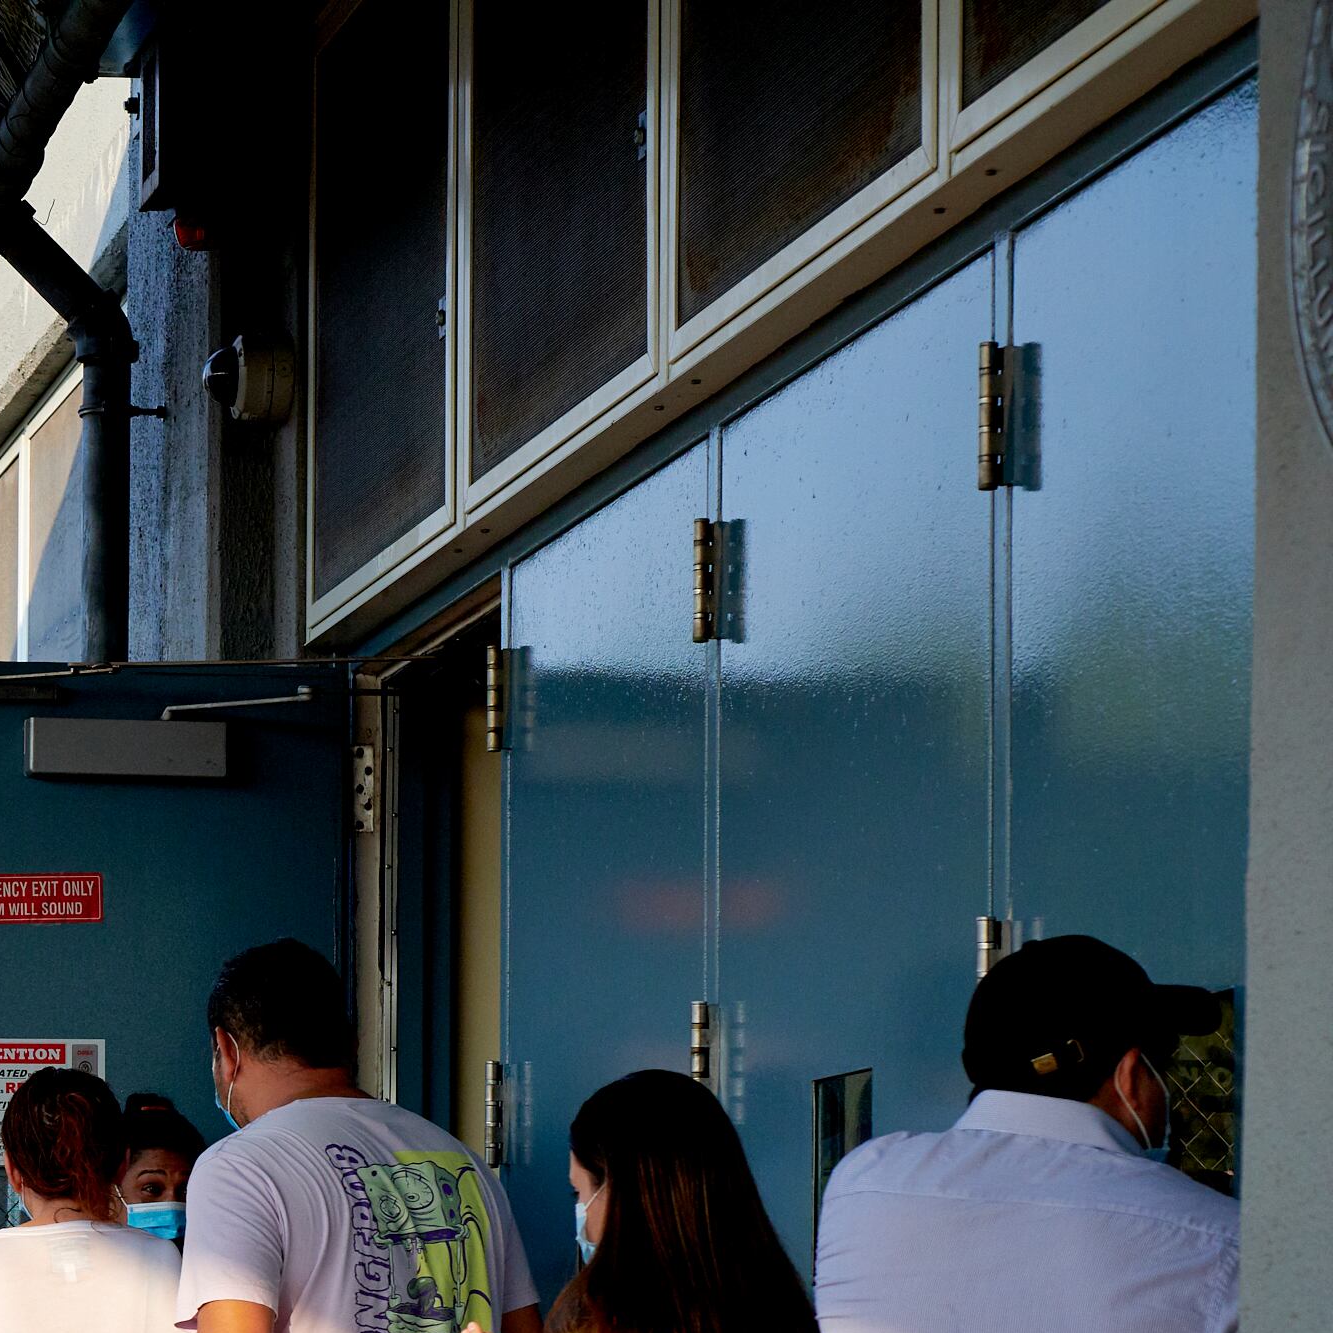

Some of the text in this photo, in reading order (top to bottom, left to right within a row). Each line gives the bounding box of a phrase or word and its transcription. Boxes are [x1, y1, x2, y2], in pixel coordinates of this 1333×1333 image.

[32, 881, 59, 897] EXIT
[62, 880, 95, 897] ONLY
[8, 902, 38, 916] WILL
[41, 902, 83, 915] SOUND
